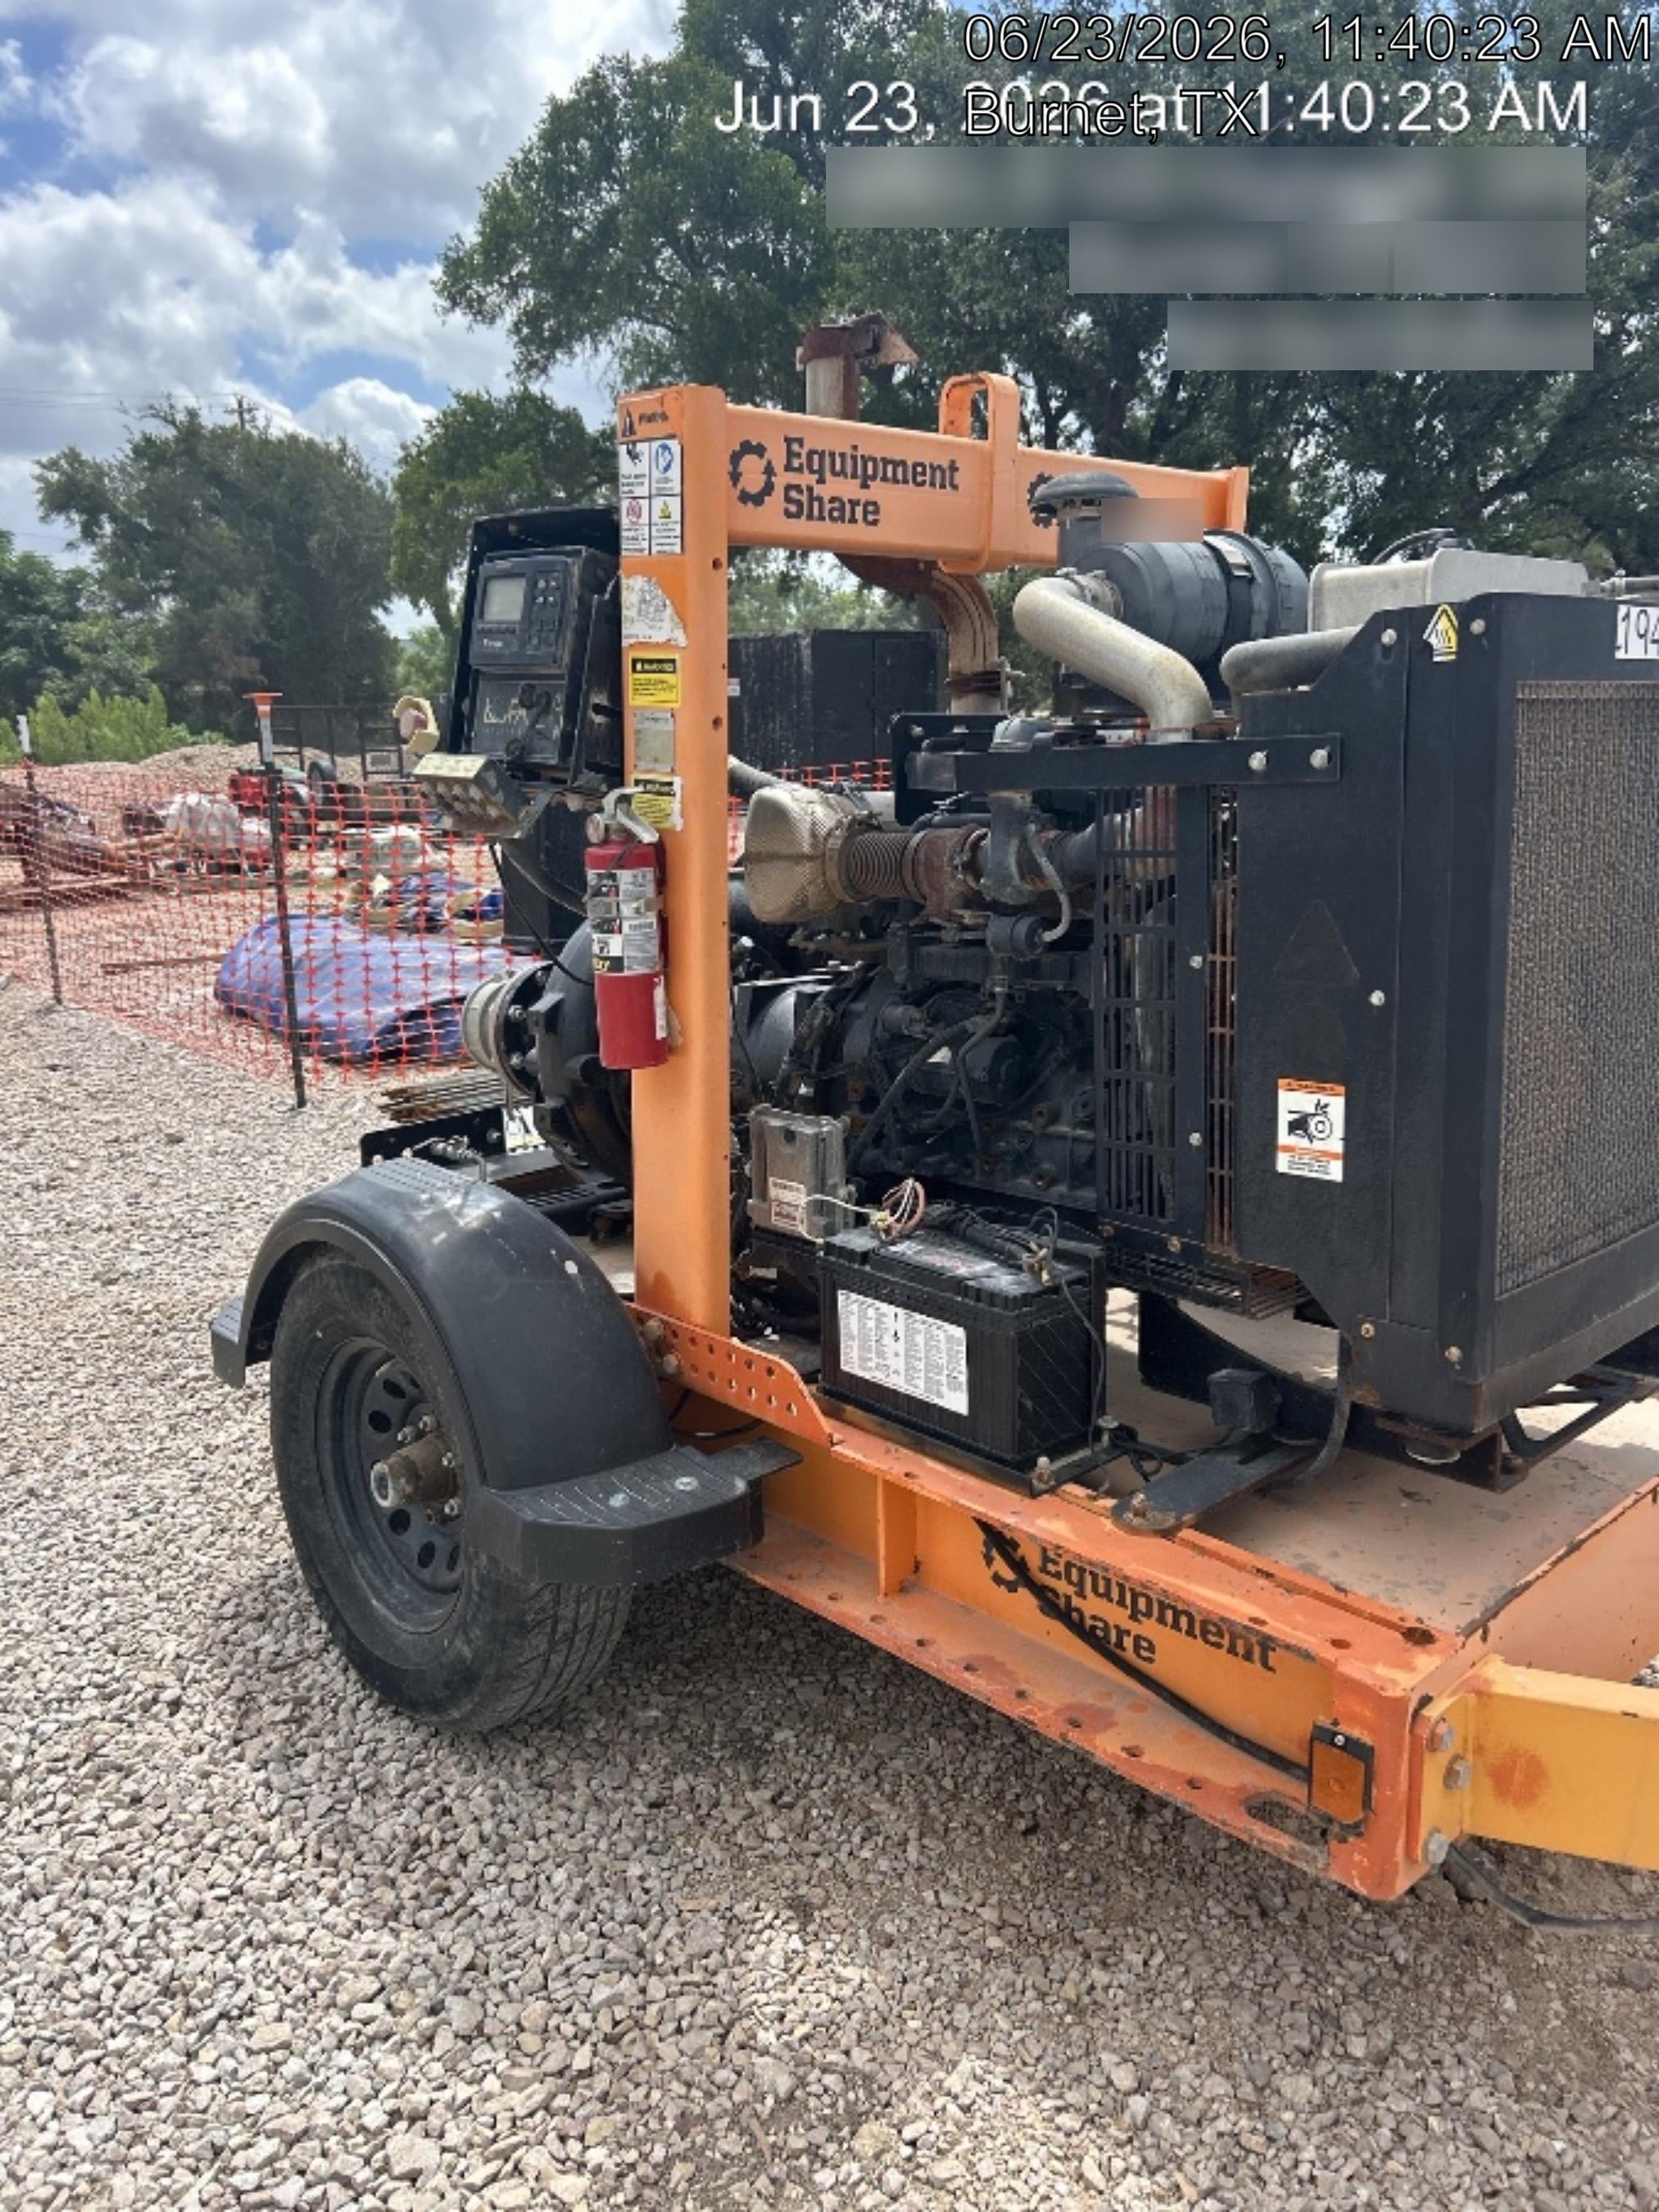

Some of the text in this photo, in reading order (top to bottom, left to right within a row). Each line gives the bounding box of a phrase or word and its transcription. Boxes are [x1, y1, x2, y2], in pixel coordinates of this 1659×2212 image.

[783, 435, 959, 492] Equipment
[782, 482, 881, 527] Share
[1037, 1544, 1277, 1674] Equipment
